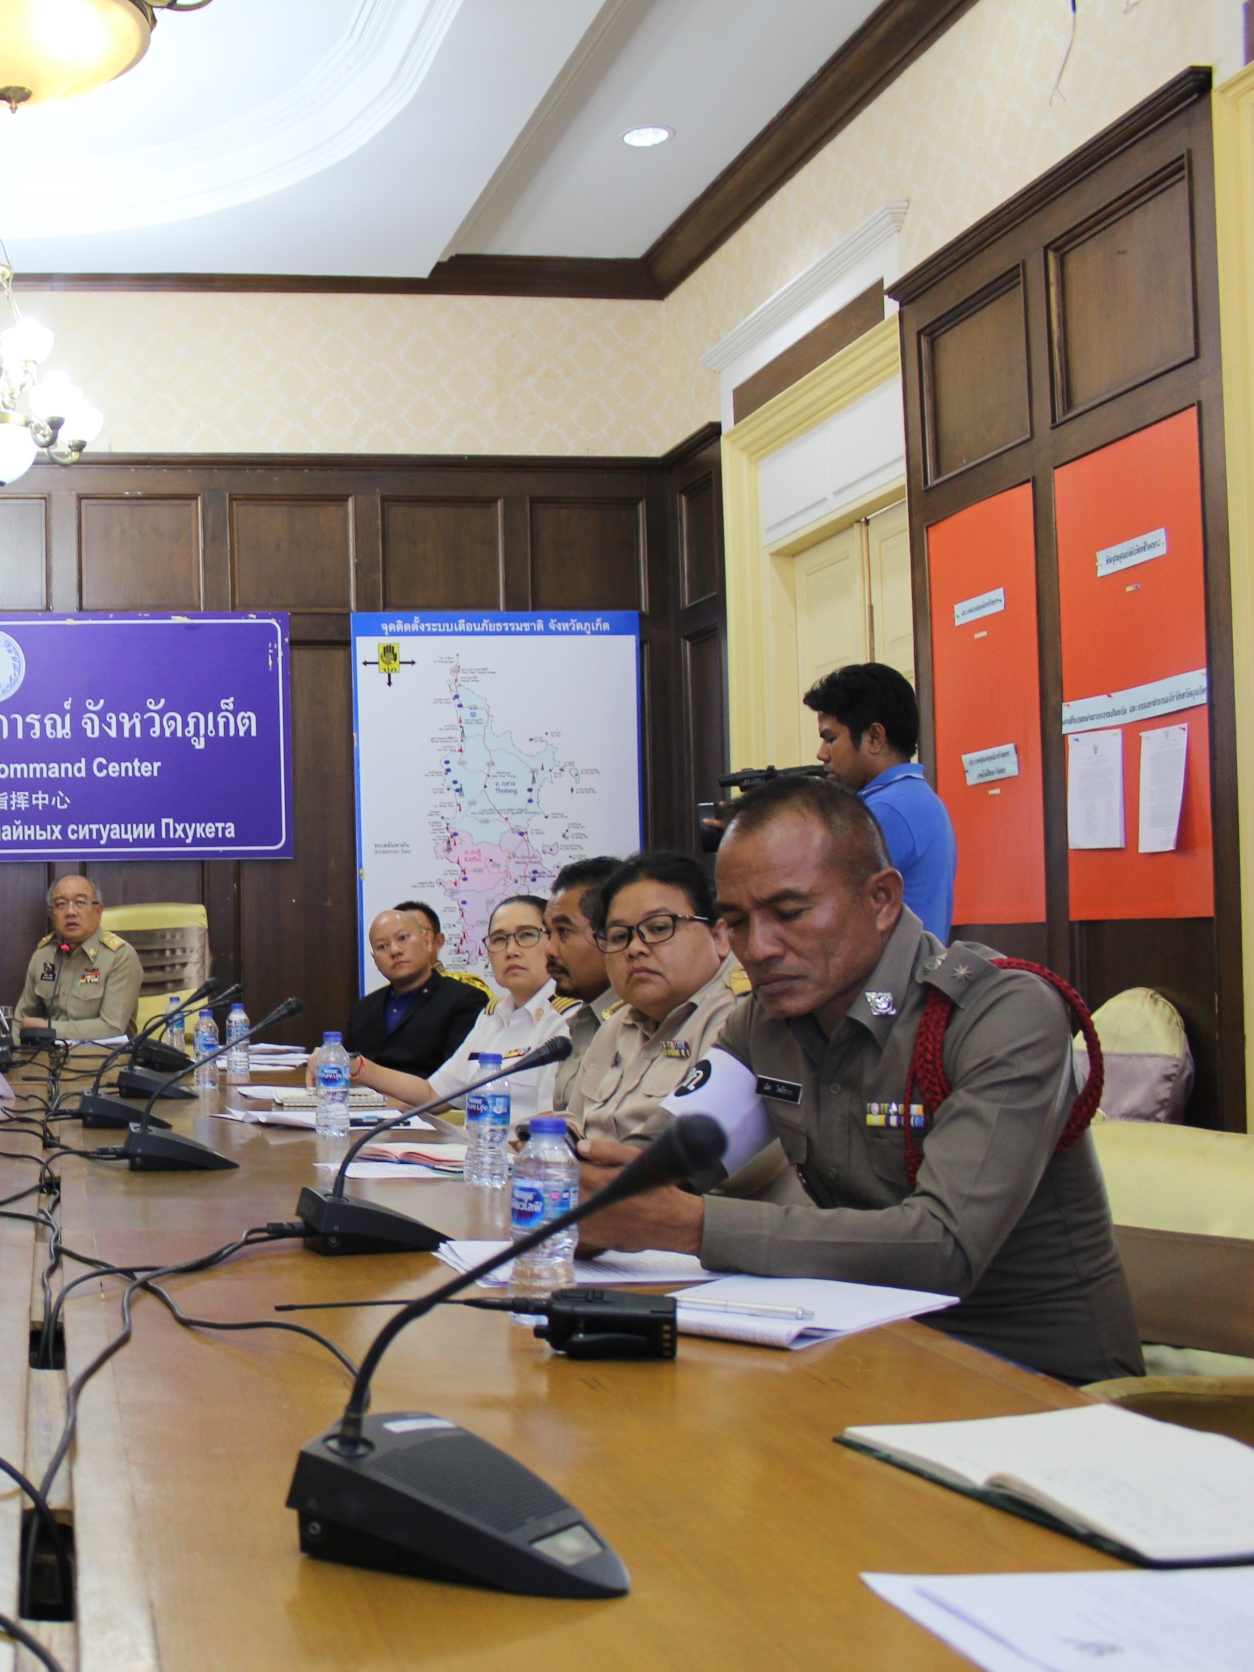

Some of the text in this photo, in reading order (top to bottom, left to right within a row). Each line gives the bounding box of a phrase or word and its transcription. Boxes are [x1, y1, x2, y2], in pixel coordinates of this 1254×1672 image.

[548, 618, 610, 635] จังหวัดภูเก็ต
[81, 697, 258, 750] จังหวัดภูเก็ต
[92, 757, 162, 778] Center
[67, 821, 156, 845] ситуации
[161, 818, 236, 843] Пхукета
